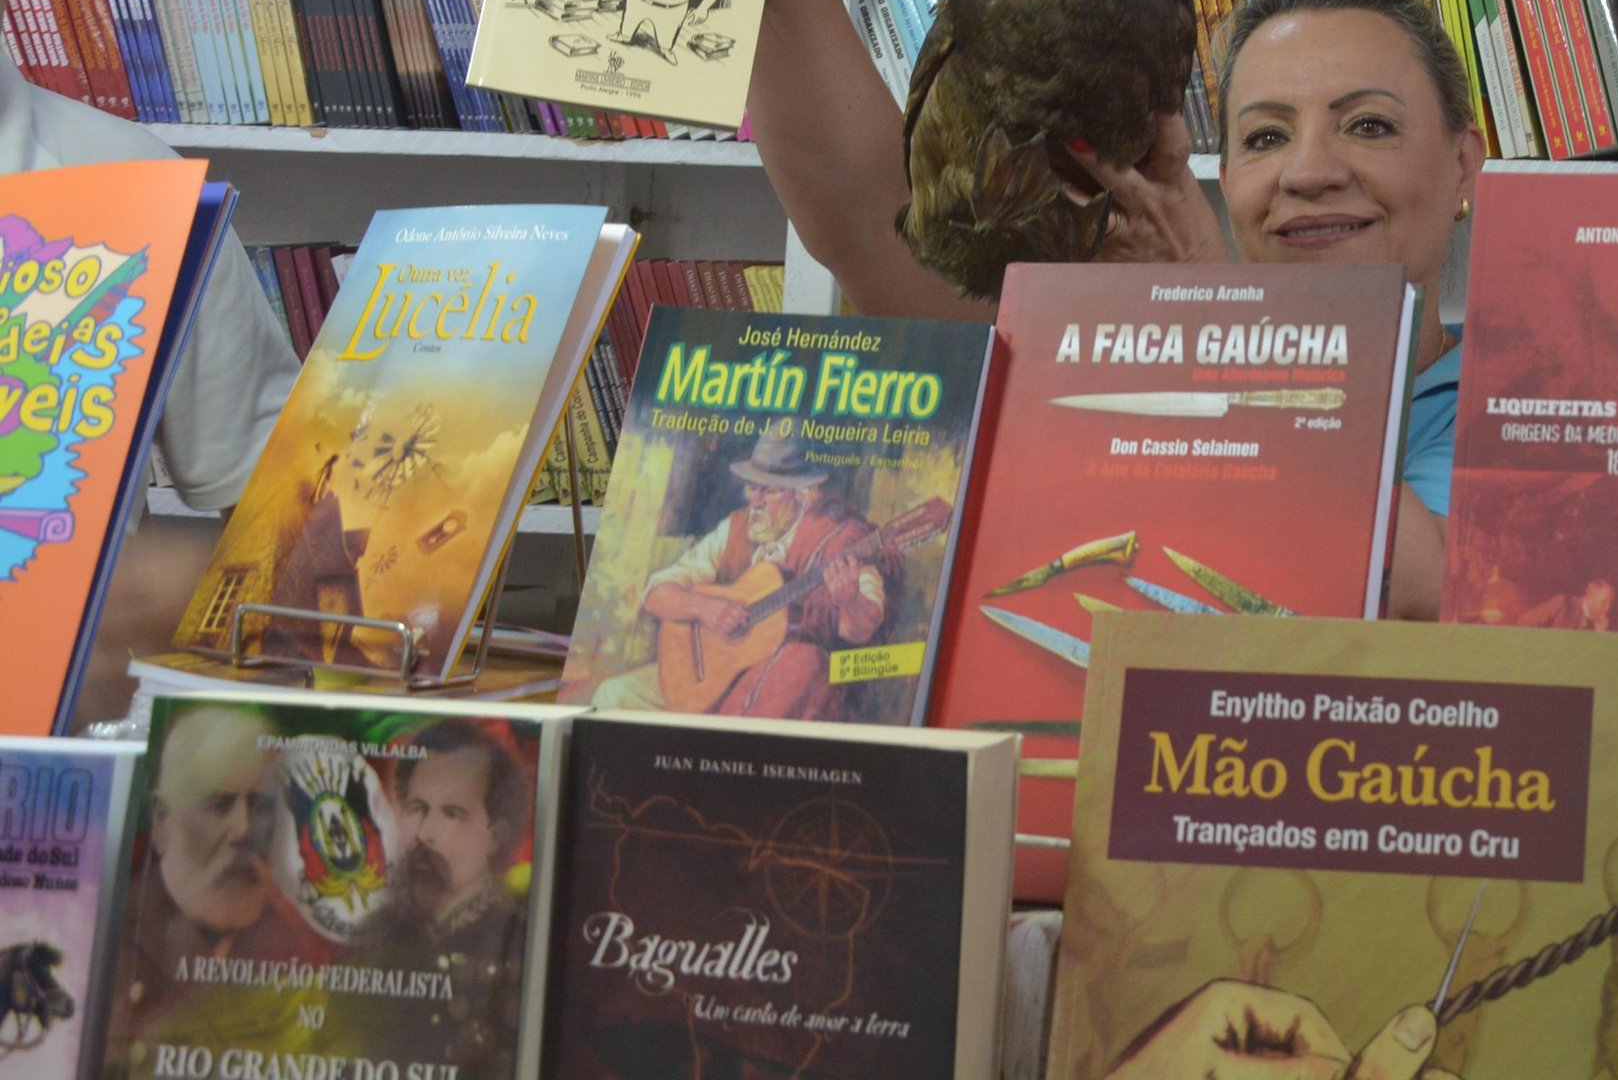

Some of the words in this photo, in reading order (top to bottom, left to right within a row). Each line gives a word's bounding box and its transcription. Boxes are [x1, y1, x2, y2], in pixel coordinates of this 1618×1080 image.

[859, 6, 883, 59] ORGANIZADO
[880, 7, 904, 60] ORGANIZADO
[396, 227, 431, 243] Odone
[486, 224, 528, 241] Silveira
[530, 224, 570, 241] Neves
[336, 259, 538, 361] Lucélia
[1151, 285, 1213, 301] Frederico
[1217, 285, 1264, 301] Aranha
[739, 326, 781, 346] José
[786, 327, 881, 351] Hernández
[1056, 323, 1081, 363] A
[1091, 323, 1184, 363] FACA
[1195, 316, 1349, 365] GAÚCHA
[656, 344, 804, 410] Martín
[814, 354, 941, 419] Fierro
[650, 408, 729, 435] Tradução
[734, 415, 755, 435] de
[759, 417, 773, 437] J.
[801, 420, 877, 444] Nogueira
[882, 422, 931, 445] Leiria
[1307, 416, 1342, 431] edição
[1486, 398, 1617, 418] LIQUEFEITAS
[1110, 437, 1138, 454] Don
[1141, 437, 1188, 456] Cassio
[1192, 439, 1260, 457] Selaimen
[1501, 423, 1560, 441] ORIGENS
[1564, 424, 1581, 441] DA
[805, 450, 861, 467] Português
[853, 650, 890, 665] Edição
[1210, 690, 1305, 723] Enyltho
[1313, 694, 1400, 724] Paixão
[1408, 698, 1499, 728] Coelho
[257, 736, 358, 756] EPAMINONDAS
[361, 743, 428, 761] VILLALBA
[654, 755, 693, 770] JUAN
[700, 758, 756, 776] DANIEL
[762, 763, 863, 785] ISERNHAGEN
[1143, 731, 1288, 800] Mão
[1306, 738, 1556, 812] Gaúcha
[1173, 815, 1317, 852] Trançados
[1324, 826, 1368, 851] em
[1377, 824, 1462, 856] Couro
[1470, 830, 1519, 859] Cru
[583, 905, 799, 997] Bagualles
[176, 957, 188, 982] A
[195, 956, 316, 994] REVOLUÇÃO
[319, 966, 454, 1001] FEDERALISTA
[297, 1005, 325, 1032] NO
[692, 994, 730, 1020] Um
[865, 1011, 912, 1039] terra
[154, 1043, 213, 1078] RIO
[219, 1050, 344, 1080] GRANDE
[351, 1057, 399, 1080] DO
[407, 1060, 460, 1080] SUL
